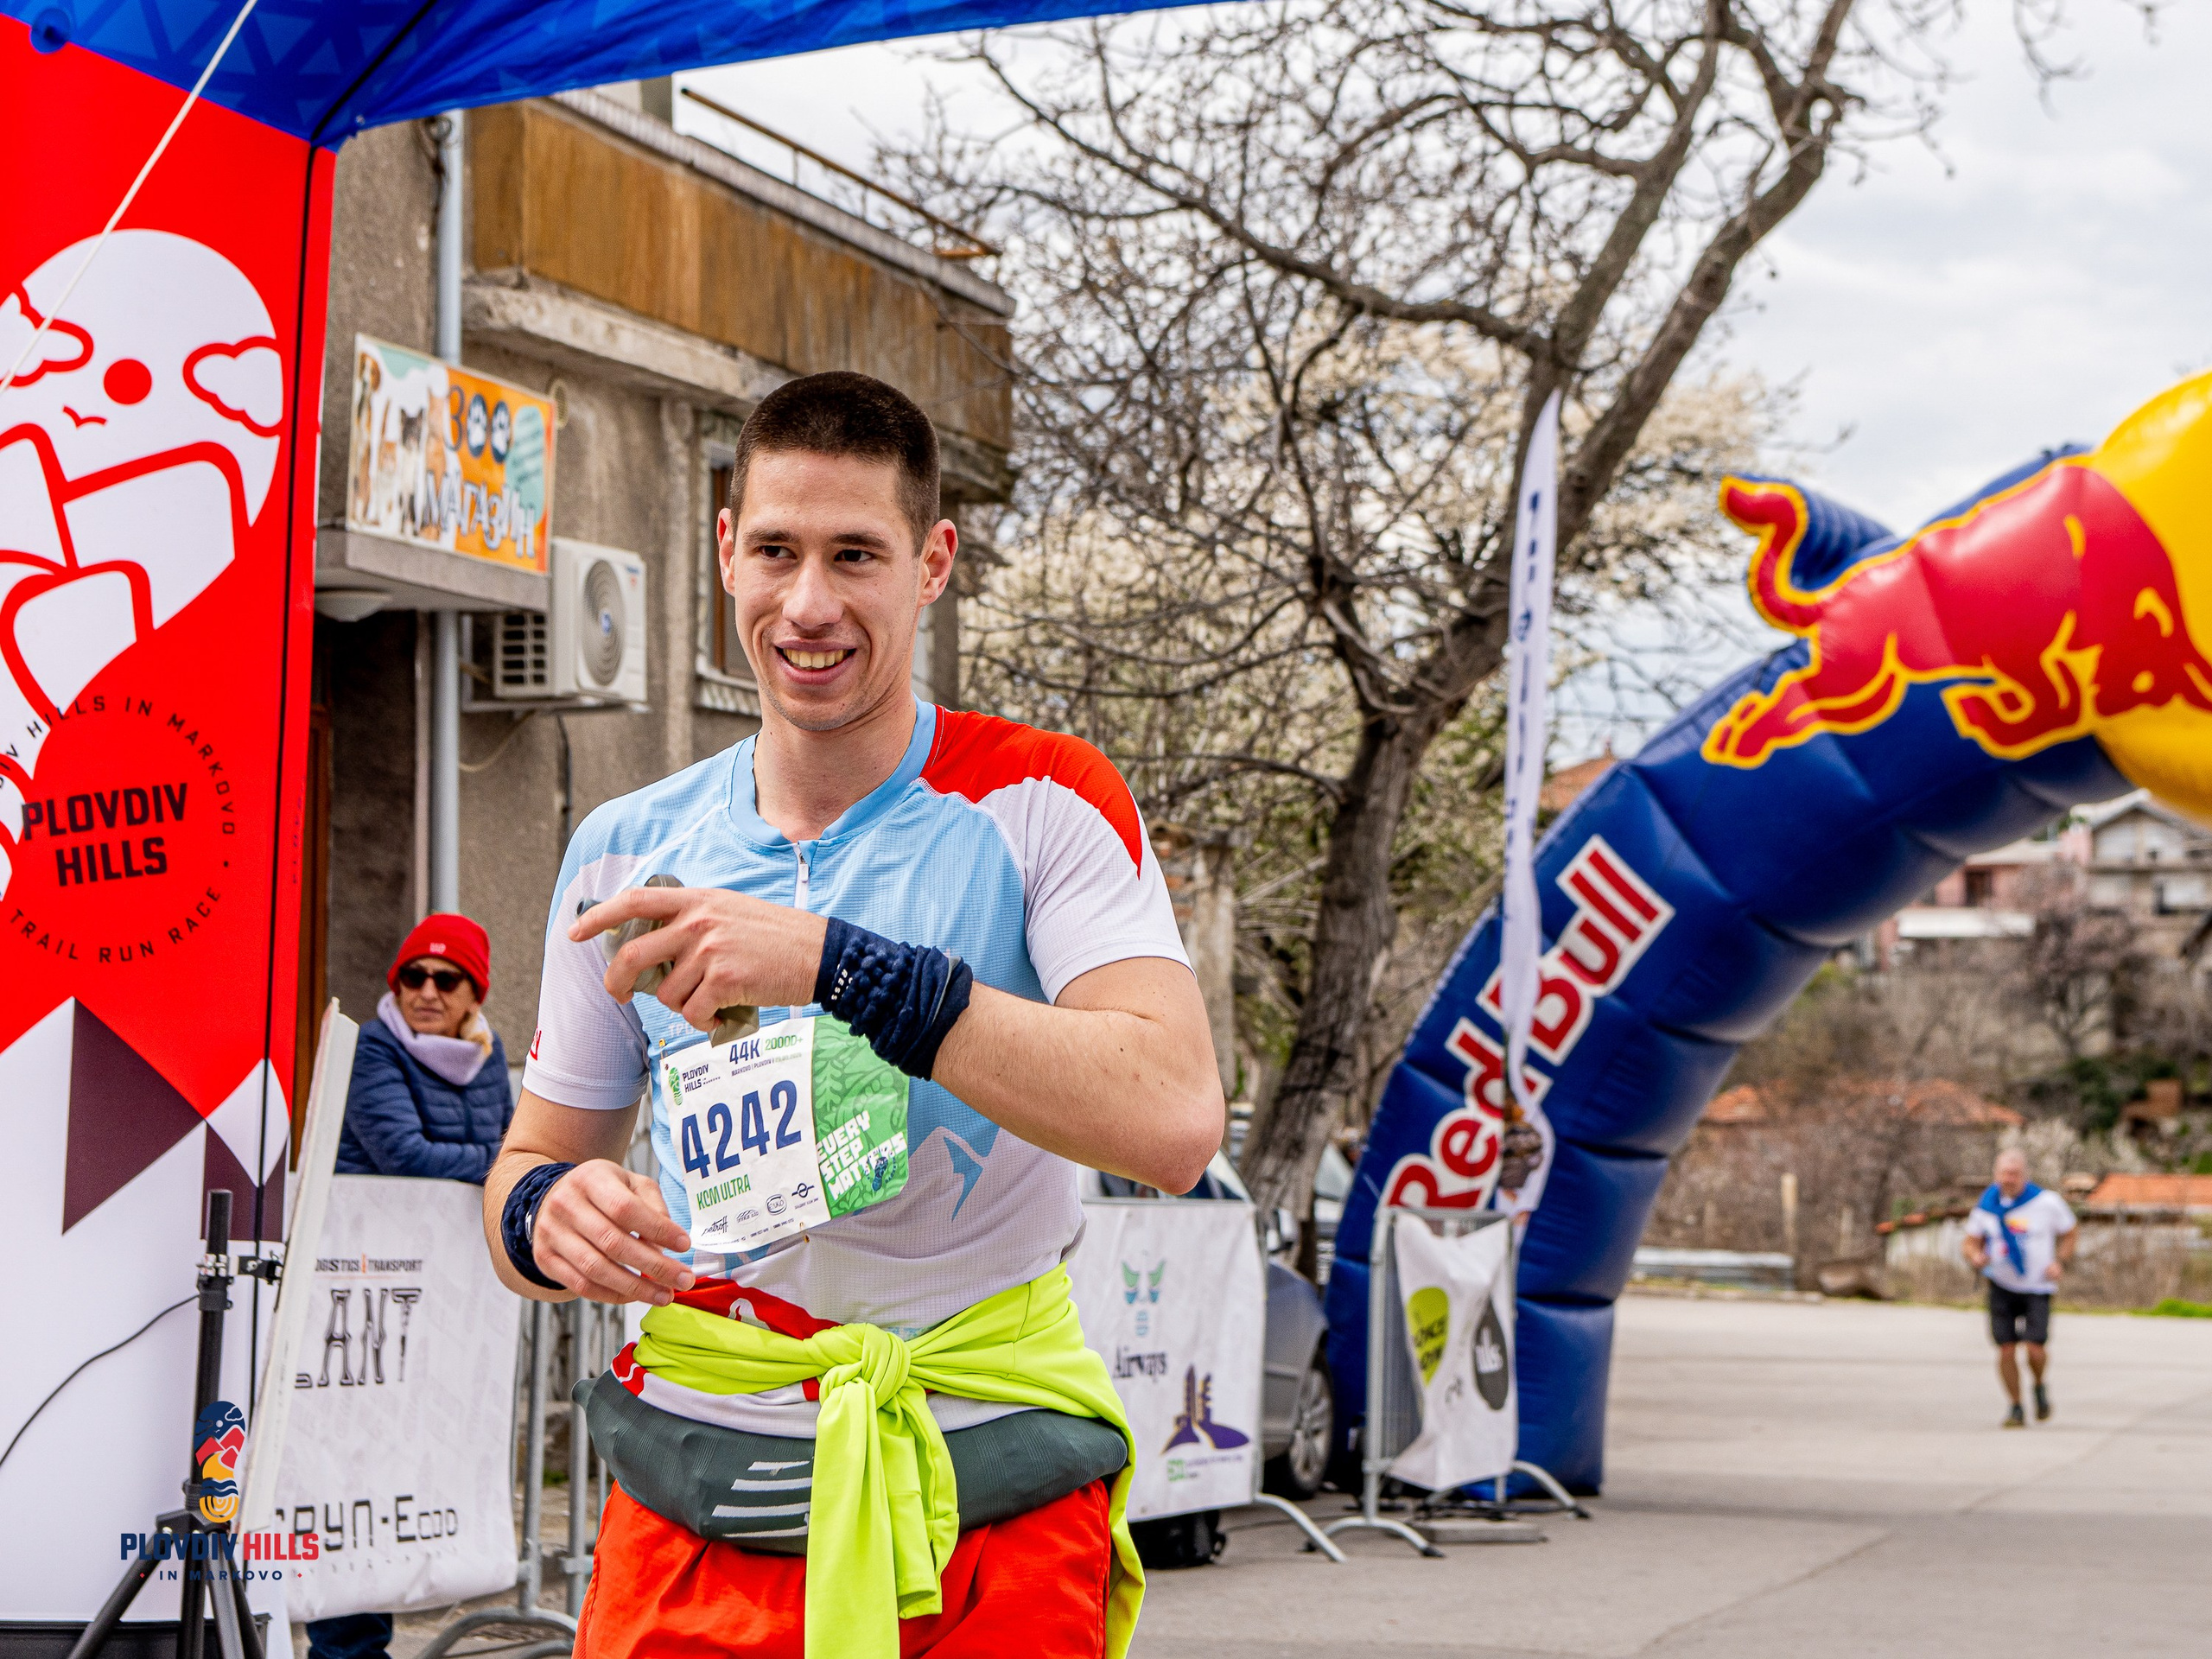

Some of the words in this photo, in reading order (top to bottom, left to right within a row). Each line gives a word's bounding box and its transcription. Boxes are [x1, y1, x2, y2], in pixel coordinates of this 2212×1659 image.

[26, 695, 105, 739] HILLS
[125, 696, 153, 717] IN
[167, 713, 236, 836] MARKOVO
[22, 782, 188, 842] PLOVDIV
[55, 836, 168, 887] HILLS
[10, 908, 79, 961] TRAIL
[99, 940, 155, 963] RUN
[168, 887, 221, 944] RACE
[682, 1064, 709, 1082] PLOVDIV
[729, 1038, 760, 1065] 44K
[765, 1034, 804, 1052] 2000D+
[684, 1079, 702, 1093] HILLS
[681, 1080, 802, 1179] 4242
[819, 1136, 864, 1183] STEP
[696, 1186, 721, 1210] KCM
[721, 1174, 752, 1201] ULTRA
[1113, 1346, 1166, 1383] Airways
